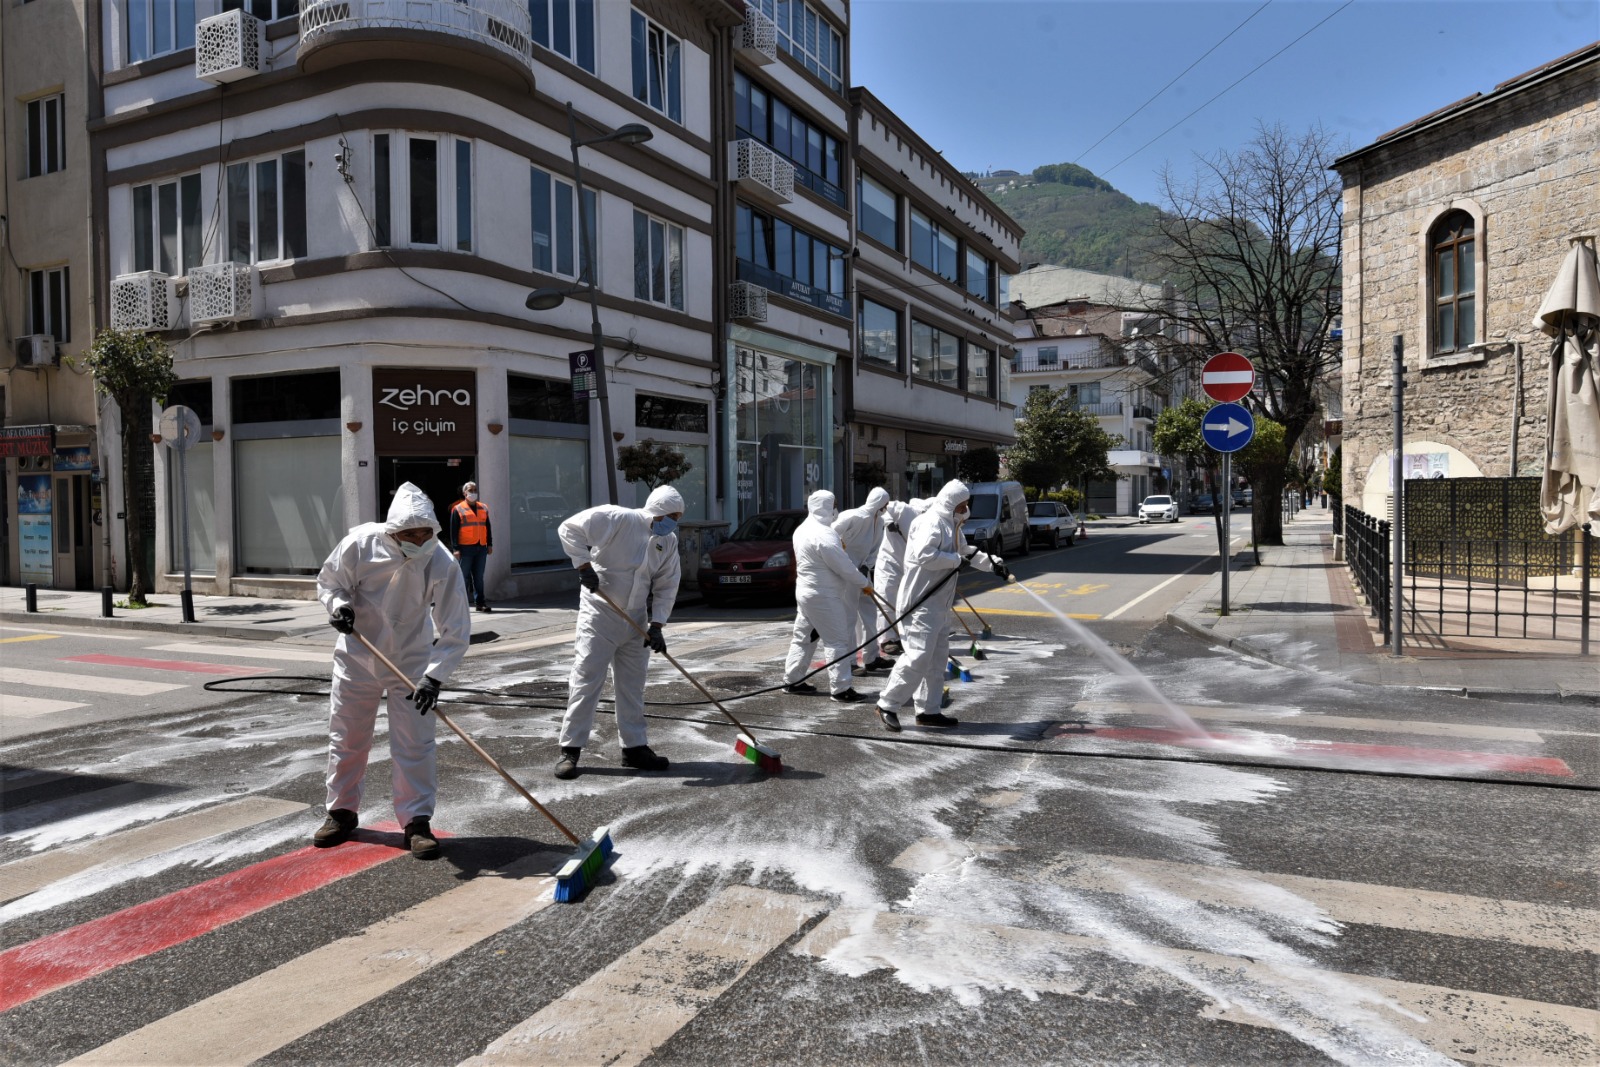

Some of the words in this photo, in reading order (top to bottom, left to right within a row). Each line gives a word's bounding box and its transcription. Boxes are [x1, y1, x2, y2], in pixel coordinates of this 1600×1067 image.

[791, 281, 811, 296] AVUKAT
[580, 356, 586, 366] P
[392, 418, 409, 435] iç
[413, 418, 456, 437] giyim
